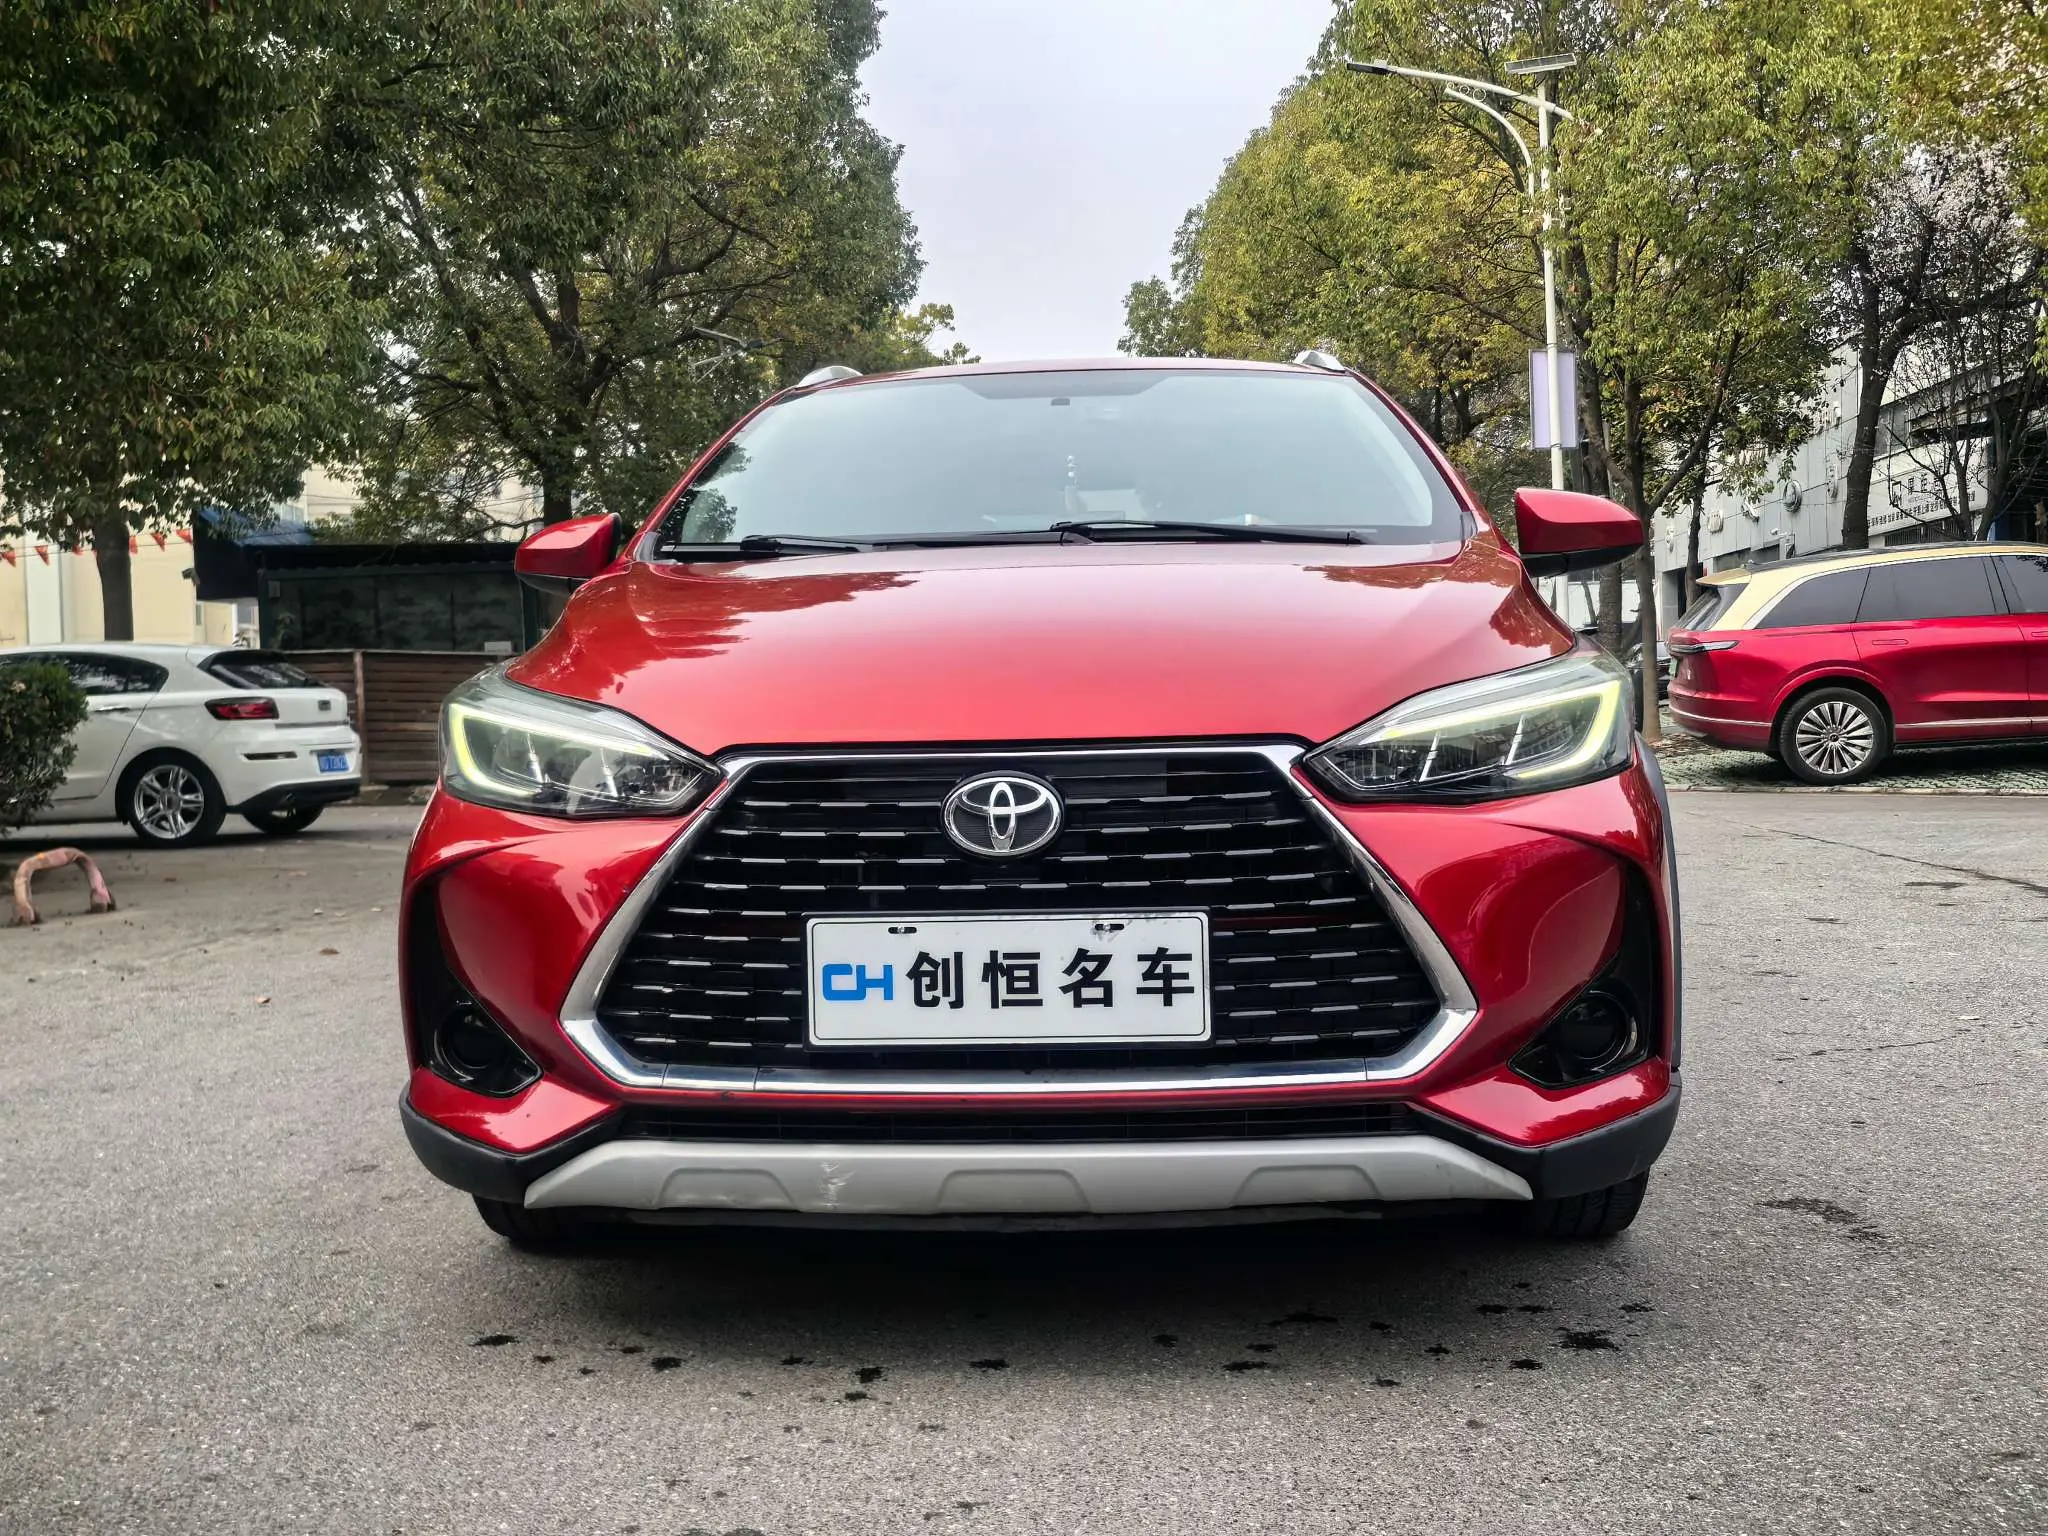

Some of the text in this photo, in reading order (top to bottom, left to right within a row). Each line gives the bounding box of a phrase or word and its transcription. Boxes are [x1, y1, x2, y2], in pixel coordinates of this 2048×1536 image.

[822, 947, 1195, 1009] CH 创恒名车
